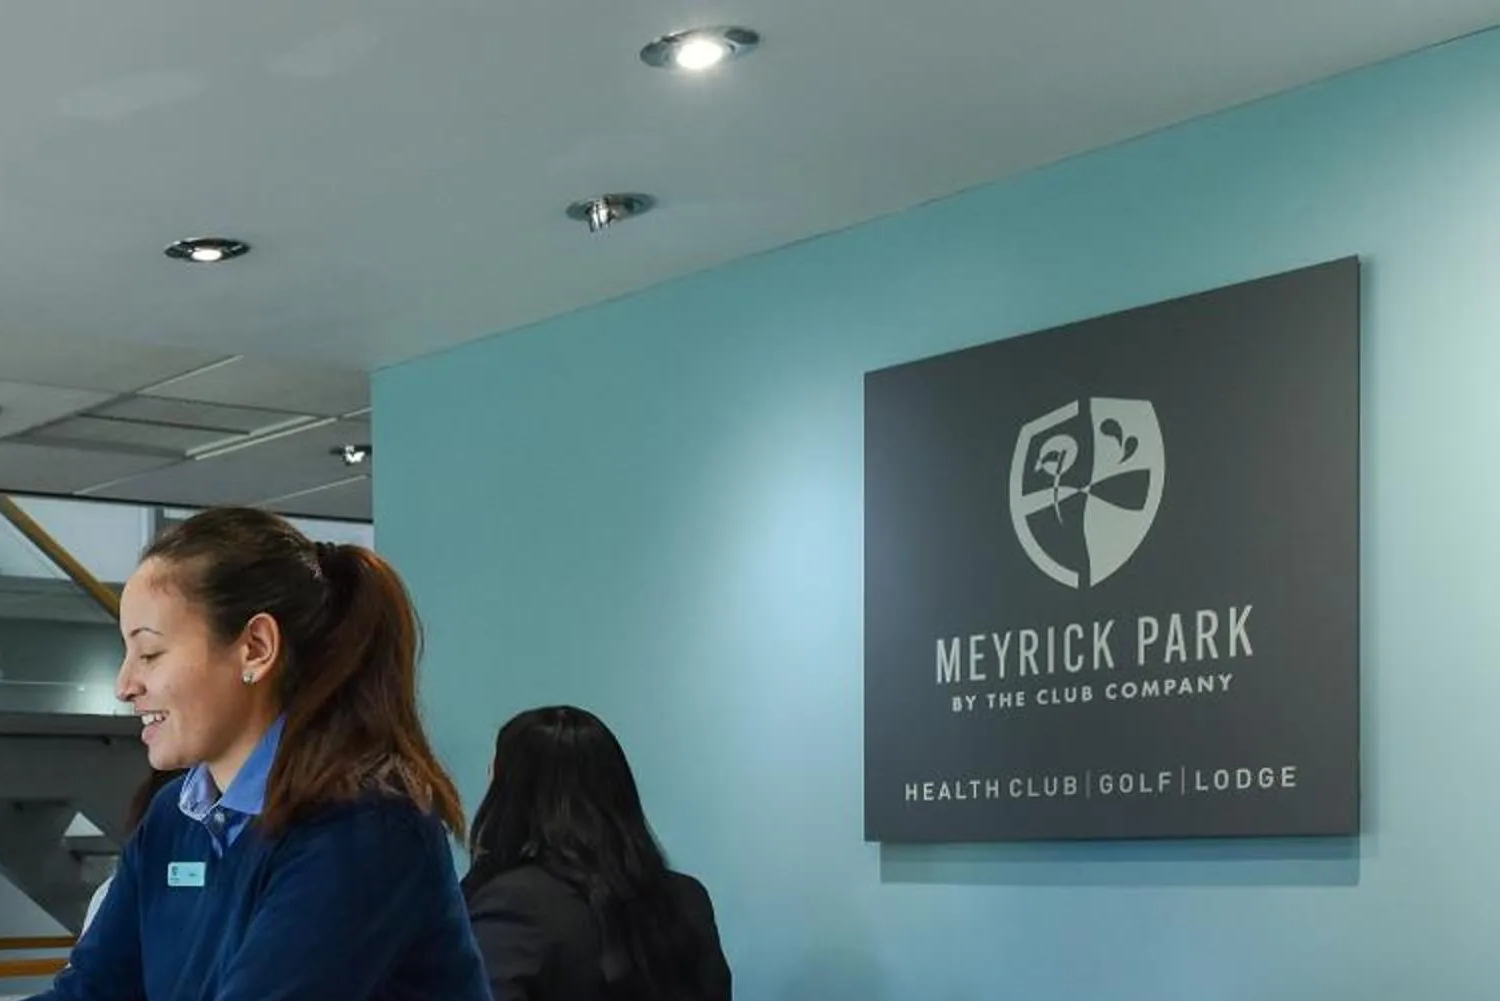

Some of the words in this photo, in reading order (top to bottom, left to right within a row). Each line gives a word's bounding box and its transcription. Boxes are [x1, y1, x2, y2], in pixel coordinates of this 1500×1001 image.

[936, 619, 1115, 684] MEYRICK
[1137, 604, 1254, 666] PARK
[952, 695, 977, 712] BY
[988, 692, 1025, 709] THE
[1036, 686, 1093, 705] CLUB
[1105, 673, 1233, 700] COMPANY
[905, 779, 1000, 802] HEALTH
[1009, 775, 1078, 798] CLUB
[1099, 771, 1172, 795] GOLF
[1195, 766, 1297, 792] LODGE
